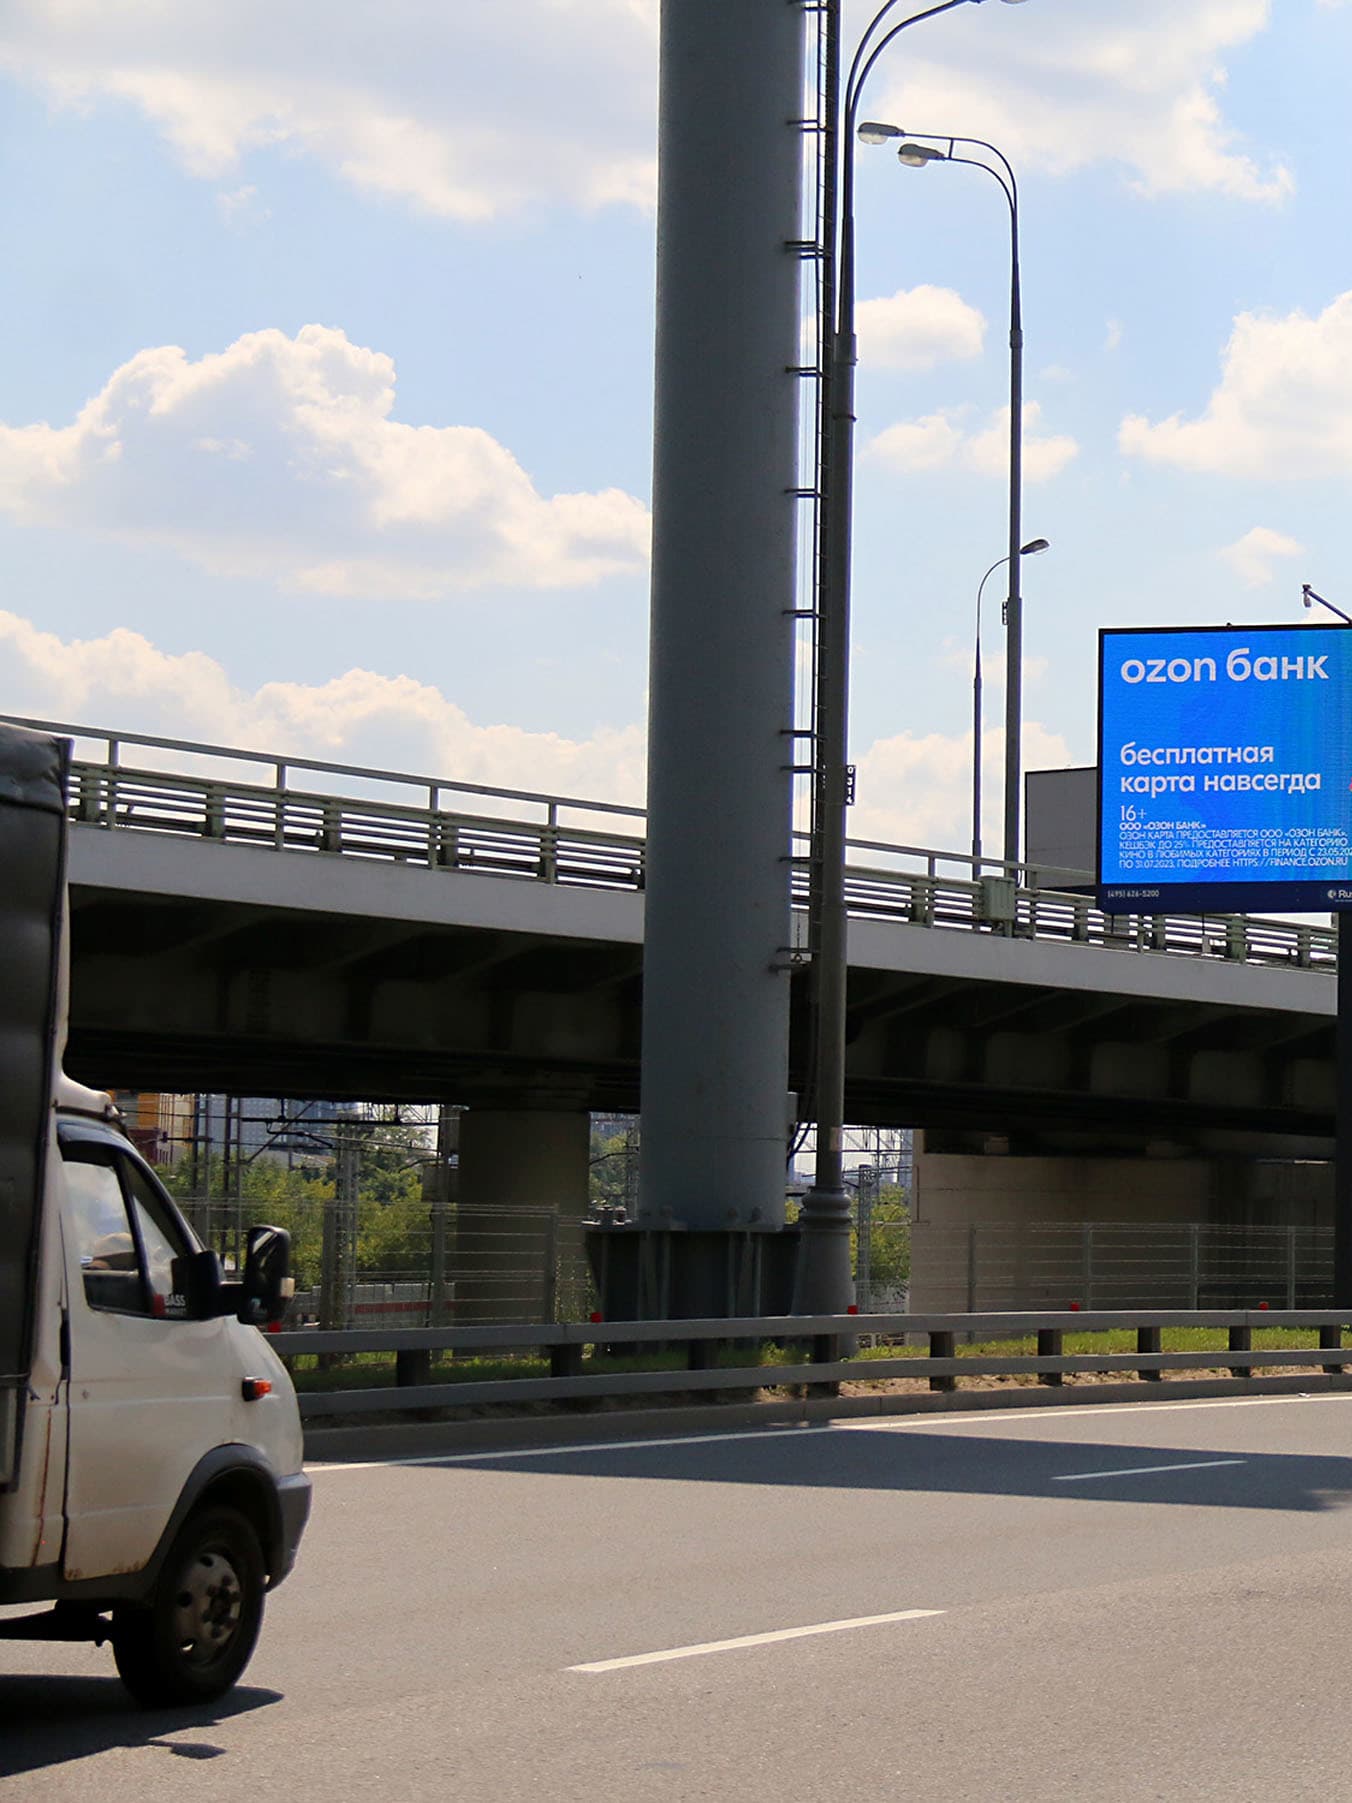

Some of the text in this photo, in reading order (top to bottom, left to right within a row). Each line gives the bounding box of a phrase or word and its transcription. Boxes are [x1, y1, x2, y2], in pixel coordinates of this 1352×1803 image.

[1120, 647, 1329, 684] ozon банк
[1120, 741, 1275, 766] бесплатная
[1120, 773, 1321, 799] карта навсегда
[1120, 804, 1147, 822] 16+
[1119, 821, 1142, 831] ООО
[1119, 831, 1146, 841] ОЗОН
[1147, 830, 1174, 841] КАРТА
[1175, 829, 1259, 841] ПРЕДОСТАВЛЯЕТСЯ
[1259, 828, 1283, 839] ООО
[1119, 841, 1156, 851] КЕШБЭК
[1157, 840, 1173, 851] ДО
[1192, 838, 1277, 850] ПРЕДОСТАВЛЯЕТСЯ
[1277, 838, 1292, 848] НА
[1293, 837, 1349, 849] КАТЕГОРИЮ
[1119, 850, 1146, 860] КИНО
[1147, 850, 1154, 859] В
[1155, 849, 1205, 860] ЛЮБИМЫХ
[1206, 848, 1261, 859] КАТЕГОРИЯХ
[1262, 848, 1270, 857] В
[1270, 847, 1307, 858] ПЕРИОД
[1308, 847, 1317, 857] С
[1119, 860, 1135, 870] ПО
[1176, 858, 1231, 870] ПОДРОБНЕЕ
